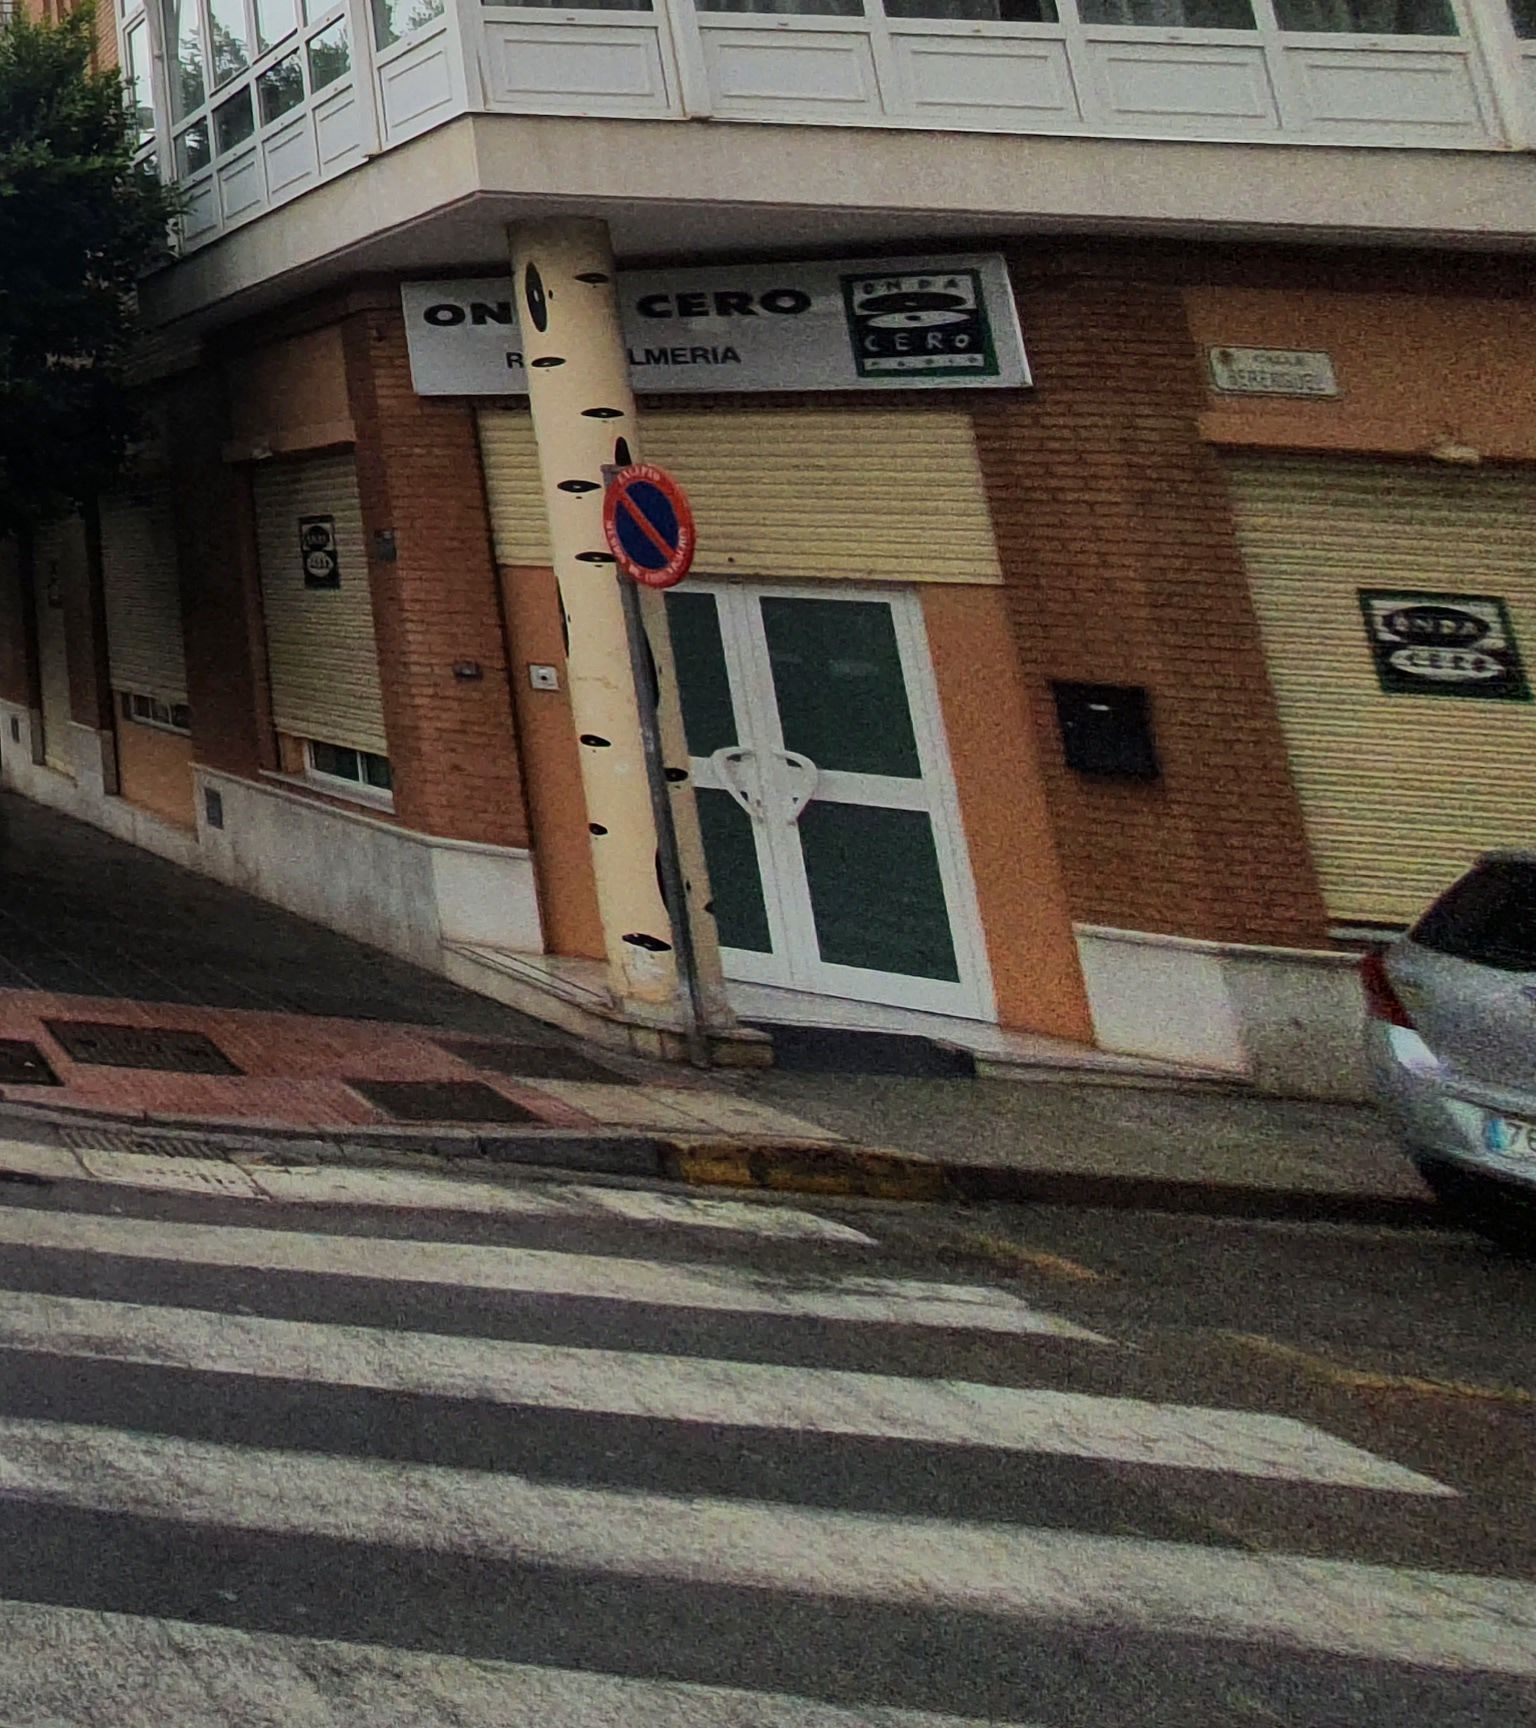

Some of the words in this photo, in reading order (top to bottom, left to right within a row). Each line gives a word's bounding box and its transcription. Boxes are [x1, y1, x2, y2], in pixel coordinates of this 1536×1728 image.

[862, 277, 959, 295] ONDA
[636, 288, 812, 319] CERO
[864, 332, 971, 352] CERO
[628, 345, 742, 366] LMERIA
